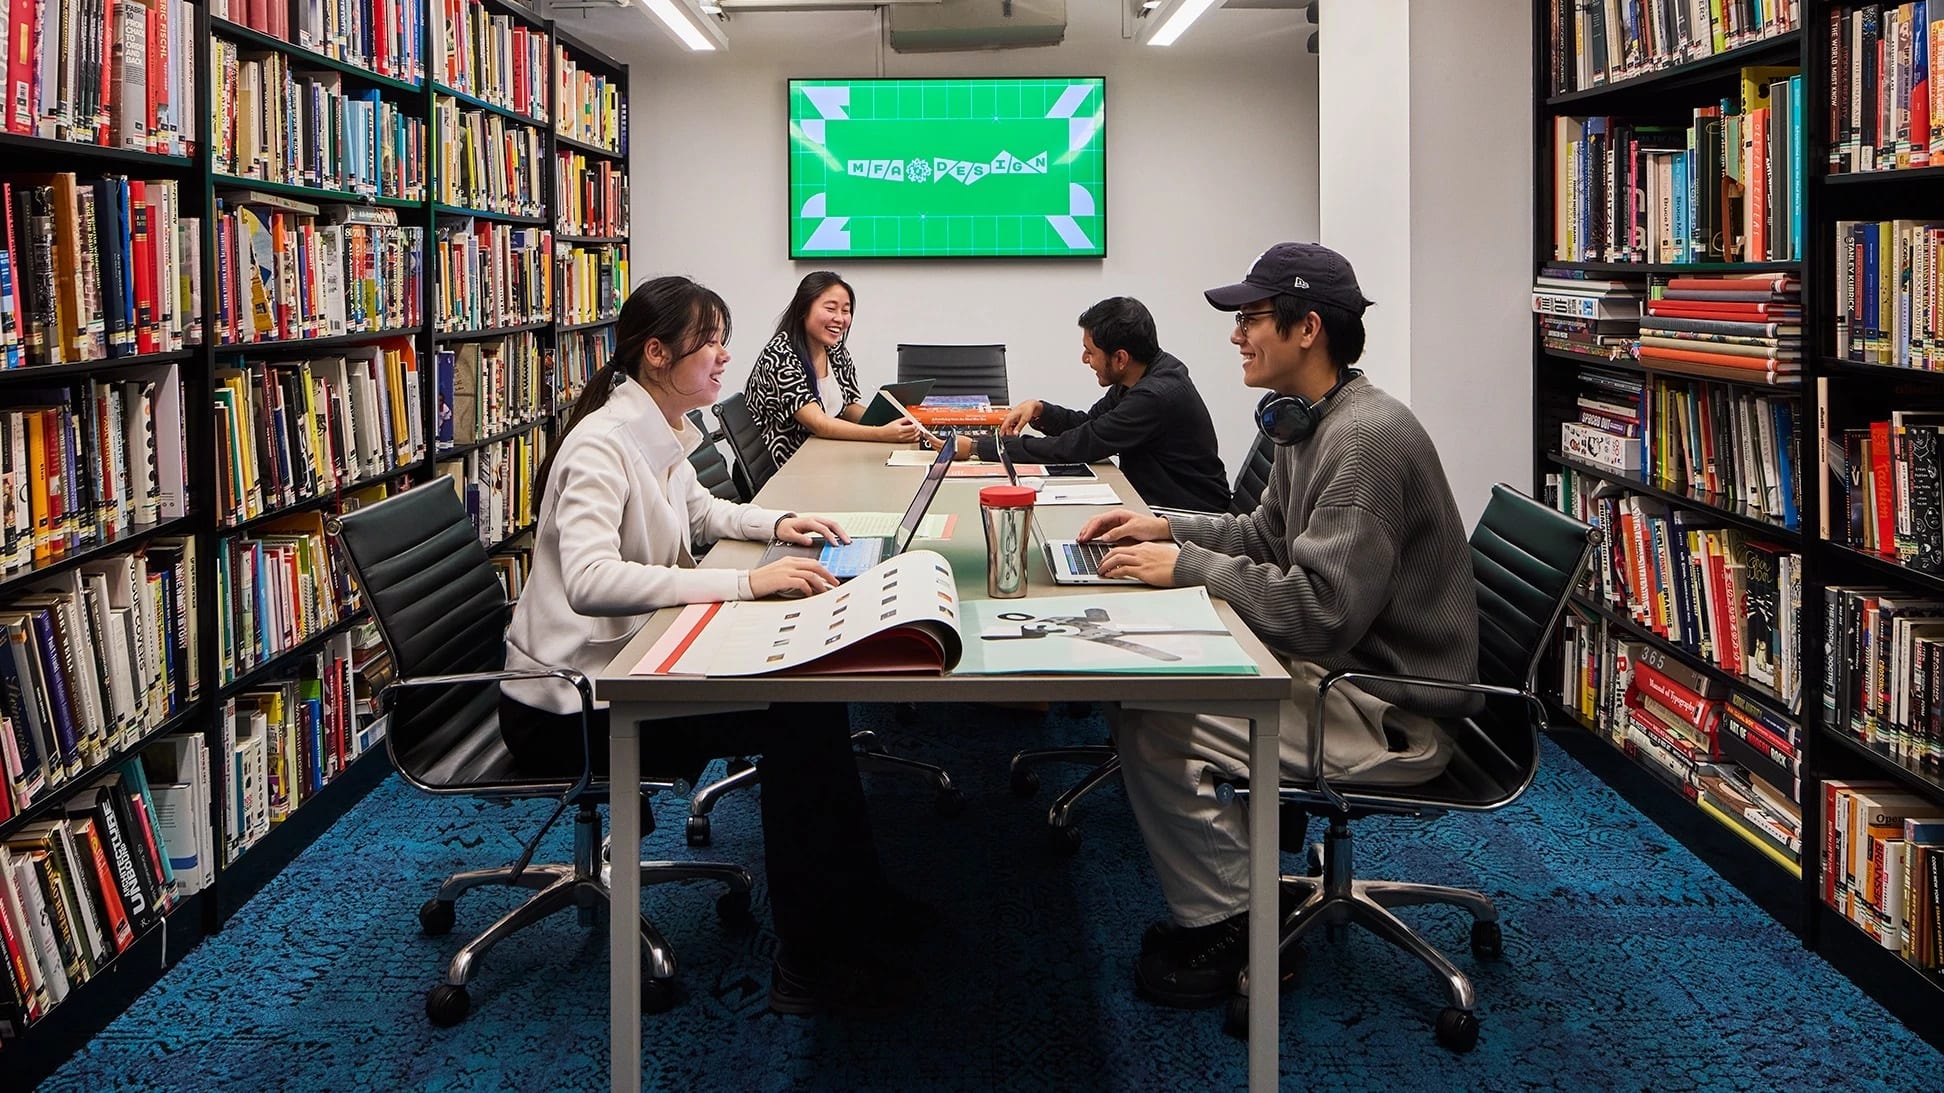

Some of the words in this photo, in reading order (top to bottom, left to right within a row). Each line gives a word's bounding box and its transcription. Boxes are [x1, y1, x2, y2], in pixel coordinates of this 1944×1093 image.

[126, 34, 136, 42] TO
[159, 23, 168, 59] FISCHL
[1831, 22, 1839, 34] THE
[125, 49, 141, 59] AND
[125, 56, 143, 65] BACK
[1831, 35, 1839, 65] WORLD
[1831, 66, 1839, 86] MUST
[1831, 86, 1839, 107] KNOW
[1754, 123, 1764, 169] OLIVER
[852, 163, 901, 176] MFA
[936, 157, 1046, 177] DESIGN
[1663, 197, 1671, 222] Bruce
[1675, 196, 1684, 221] Bruce
[1754, 178, 1764, 237] JEFFERS
[1847, 237, 1855, 274] STANLEY
[1847, 275, 1855, 312] KUBRICK
[129, 561, 141, 610] VOGUE
[1655, 525, 1664, 549] KURT
[1662, 587, 1674, 629] DRAWINGS
[134, 612, 145, 671] COVERS
[1641, 646, 1665, 670] 365
[1615, 656, 1629, 710] Berlin
[1877, 659, 1885, 693] CROSSING
[1669, 688, 1696, 714] Typography
[293, 703, 302, 752] WATERSHIP
[1729, 719, 1739, 734] ART
[1770, 747, 1788, 769] ROCK
[1876, 814, 1904, 826] Open
[102, 801, 132, 897] ARCHITECTURE
[119, 842, 146, 916] UNBOUND
[43, 858, 59, 897] DIEGO
[54, 898, 71, 945] RIVERA
